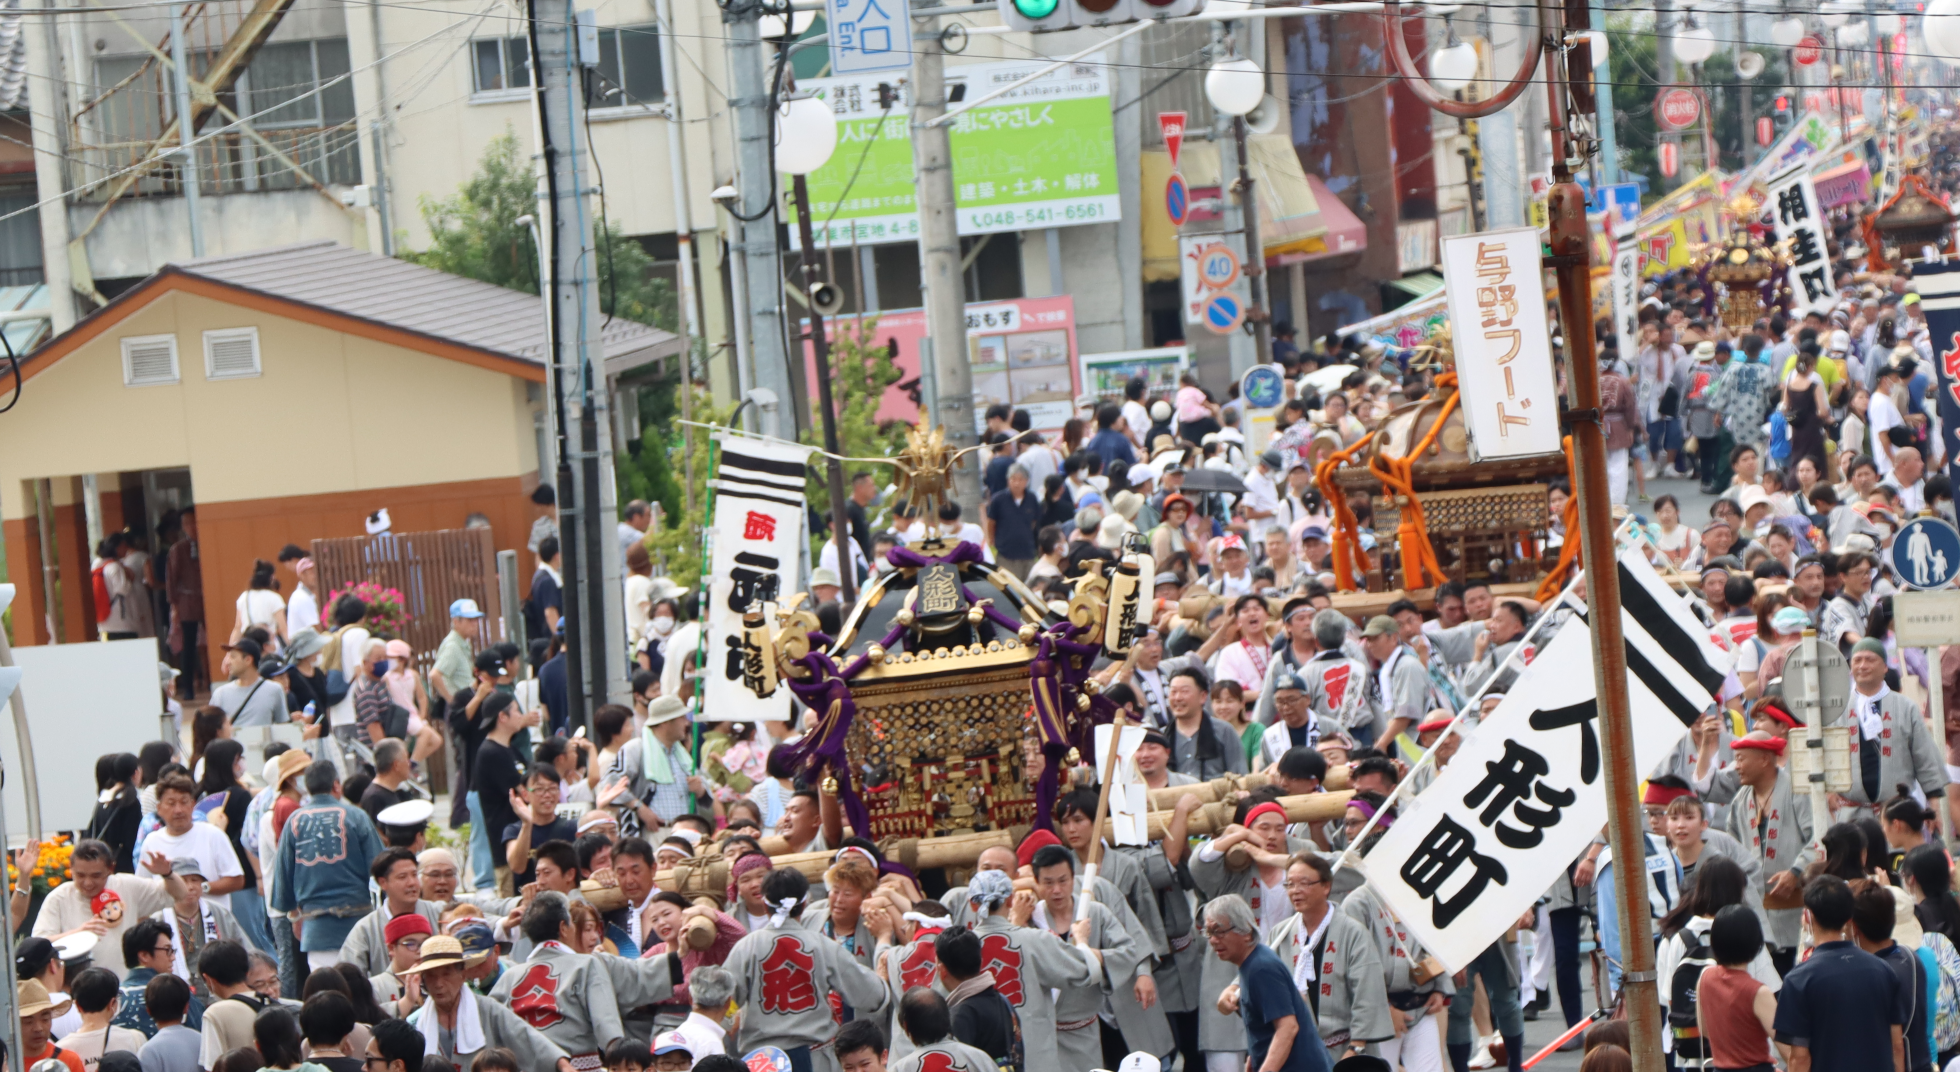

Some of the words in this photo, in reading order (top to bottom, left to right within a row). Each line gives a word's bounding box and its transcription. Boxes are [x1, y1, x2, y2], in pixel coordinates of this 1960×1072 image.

[839, 21, 855, 57] Ent.
[996, 81, 1100, 99] ww.kihara-inc.jp
[983, 203, 1105, 226] 048-541-6561
[1208, 256, 1230, 276] 40
[1475, 241, 1532, 439] 与野フード
[1401, 697, 1600, 931] 人形町
[1321, 941, 1337, 997] 人形町
